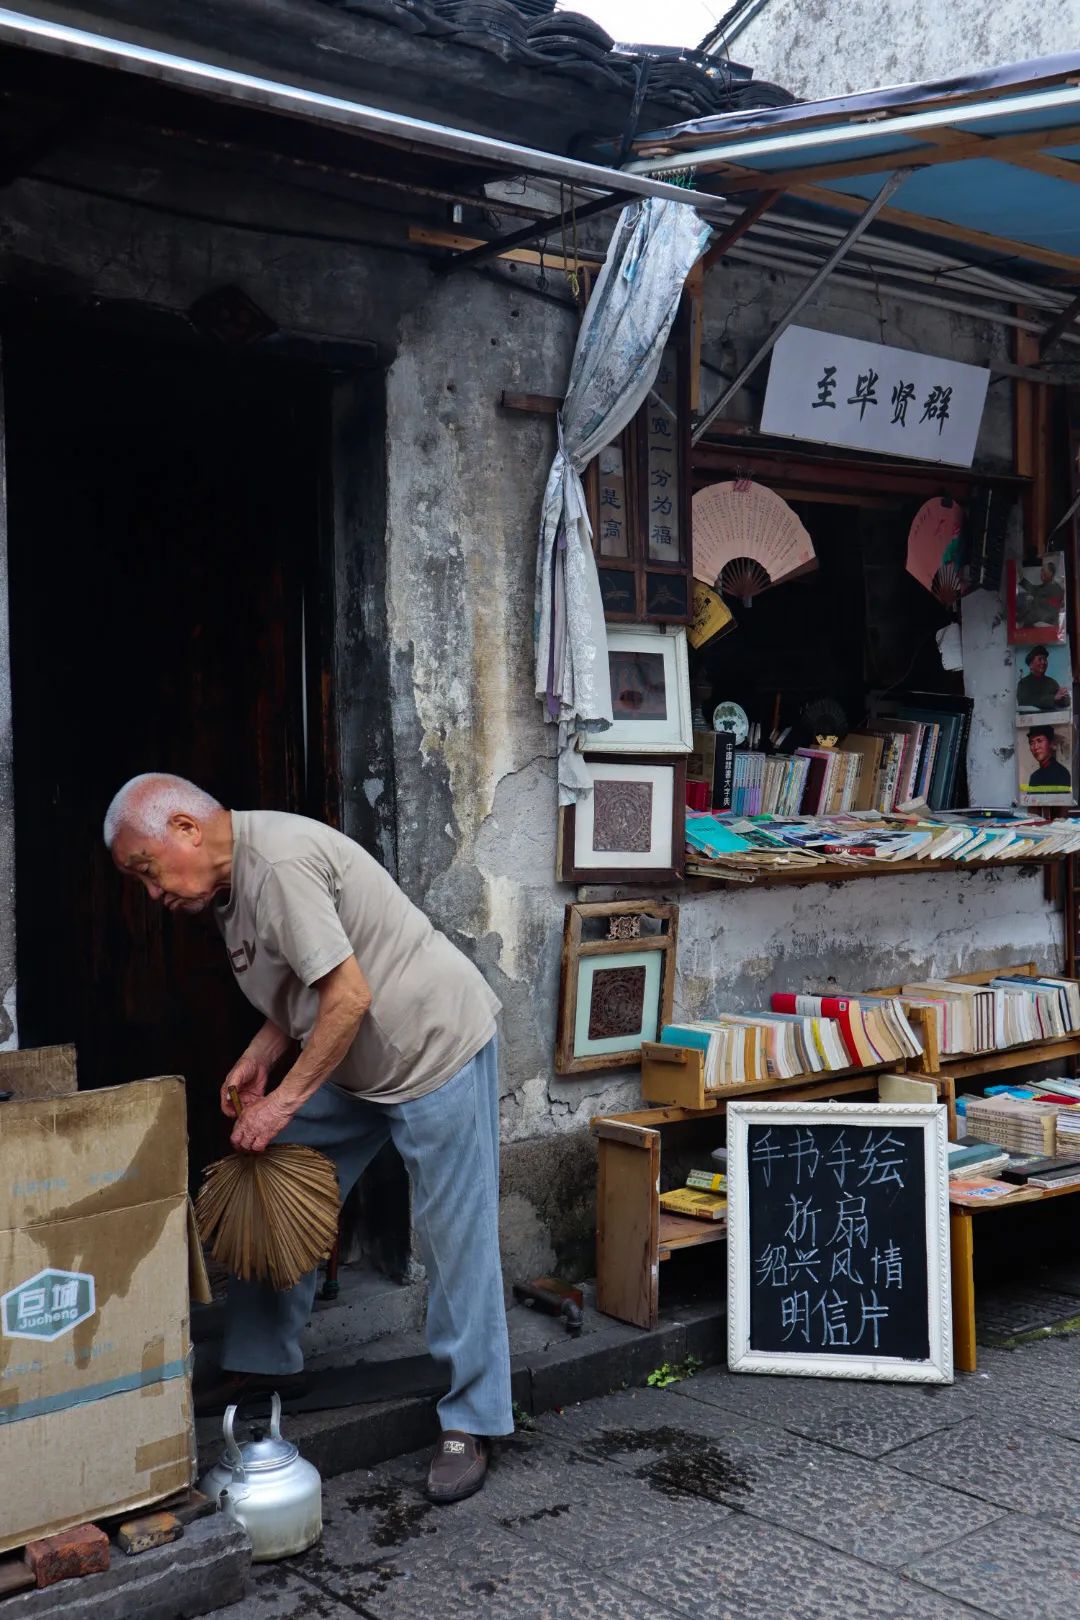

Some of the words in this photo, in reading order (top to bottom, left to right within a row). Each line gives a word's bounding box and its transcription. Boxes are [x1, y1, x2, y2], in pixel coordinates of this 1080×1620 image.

[752, 1128, 905, 1187] 手书手绘
[784, 1191, 869, 1248] 折扇
[755, 1239, 903, 1289] 绍兴风情
[19, 1308, 79, 1329] Jucheng
[781, 1289, 889, 1348] 明信片
